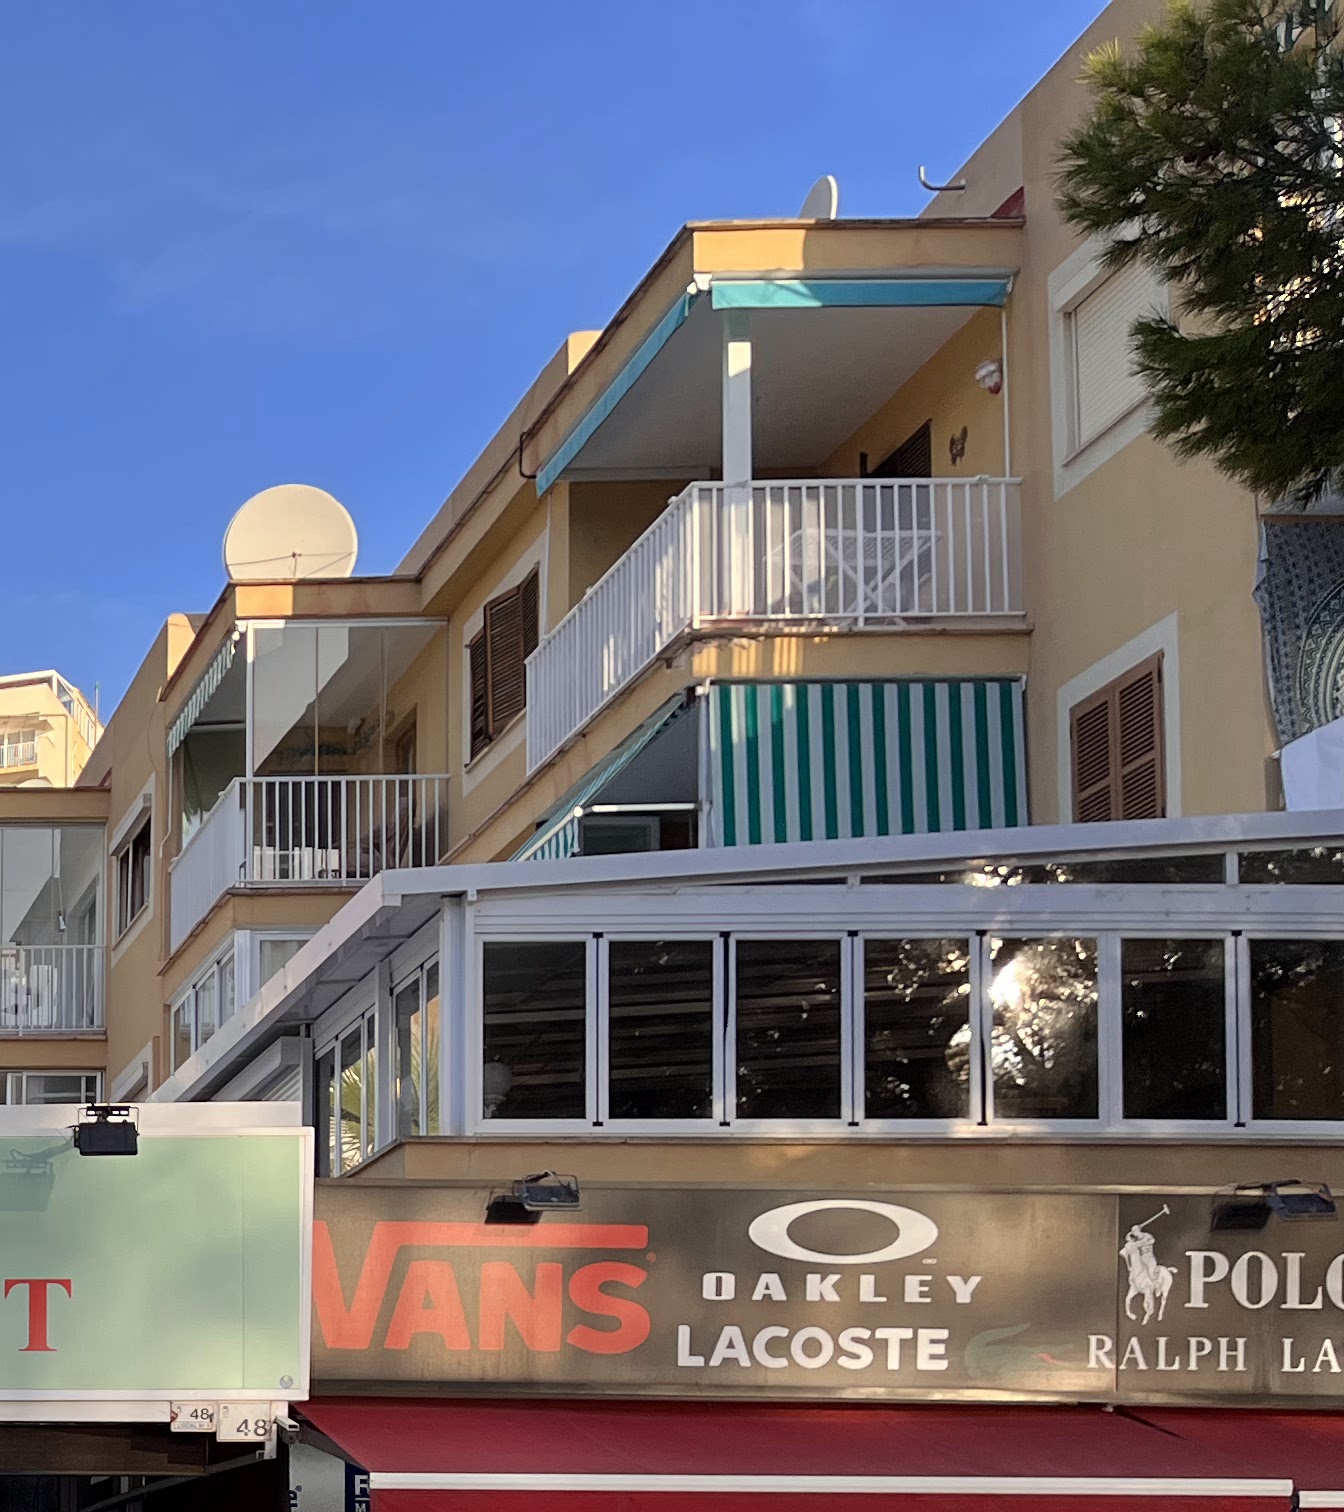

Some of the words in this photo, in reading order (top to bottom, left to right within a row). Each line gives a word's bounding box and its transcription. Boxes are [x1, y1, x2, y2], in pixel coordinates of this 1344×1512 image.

[312, 1221, 651, 1354] VANS
[702, 1272, 983, 1304] OAKLEY
[677, 1325, 950, 1371] LACOSTE
[1086, 1334, 1248, 1372] RALPH
[190, 1408, 209, 1420] 48
[236, 1419, 267, 1436] 48
